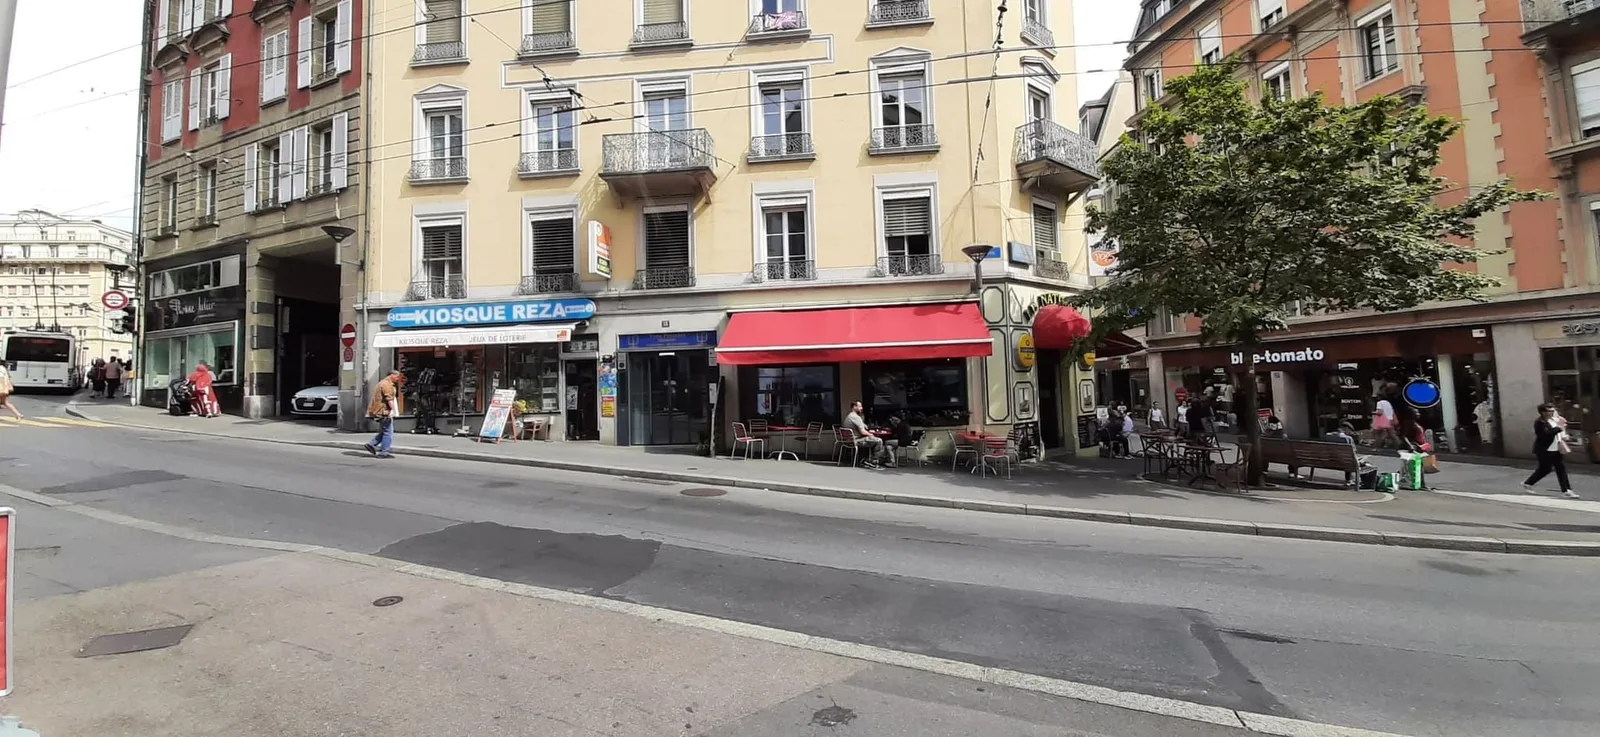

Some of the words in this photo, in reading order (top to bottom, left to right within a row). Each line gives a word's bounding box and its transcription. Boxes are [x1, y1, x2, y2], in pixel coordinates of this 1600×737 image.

[415, 304, 506, 324] KIOSQUE
[513, 303, 566, 319] REZA
[469, 335, 485, 343] JEUX
[1231, 347, 1324, 364] ble-tomato
